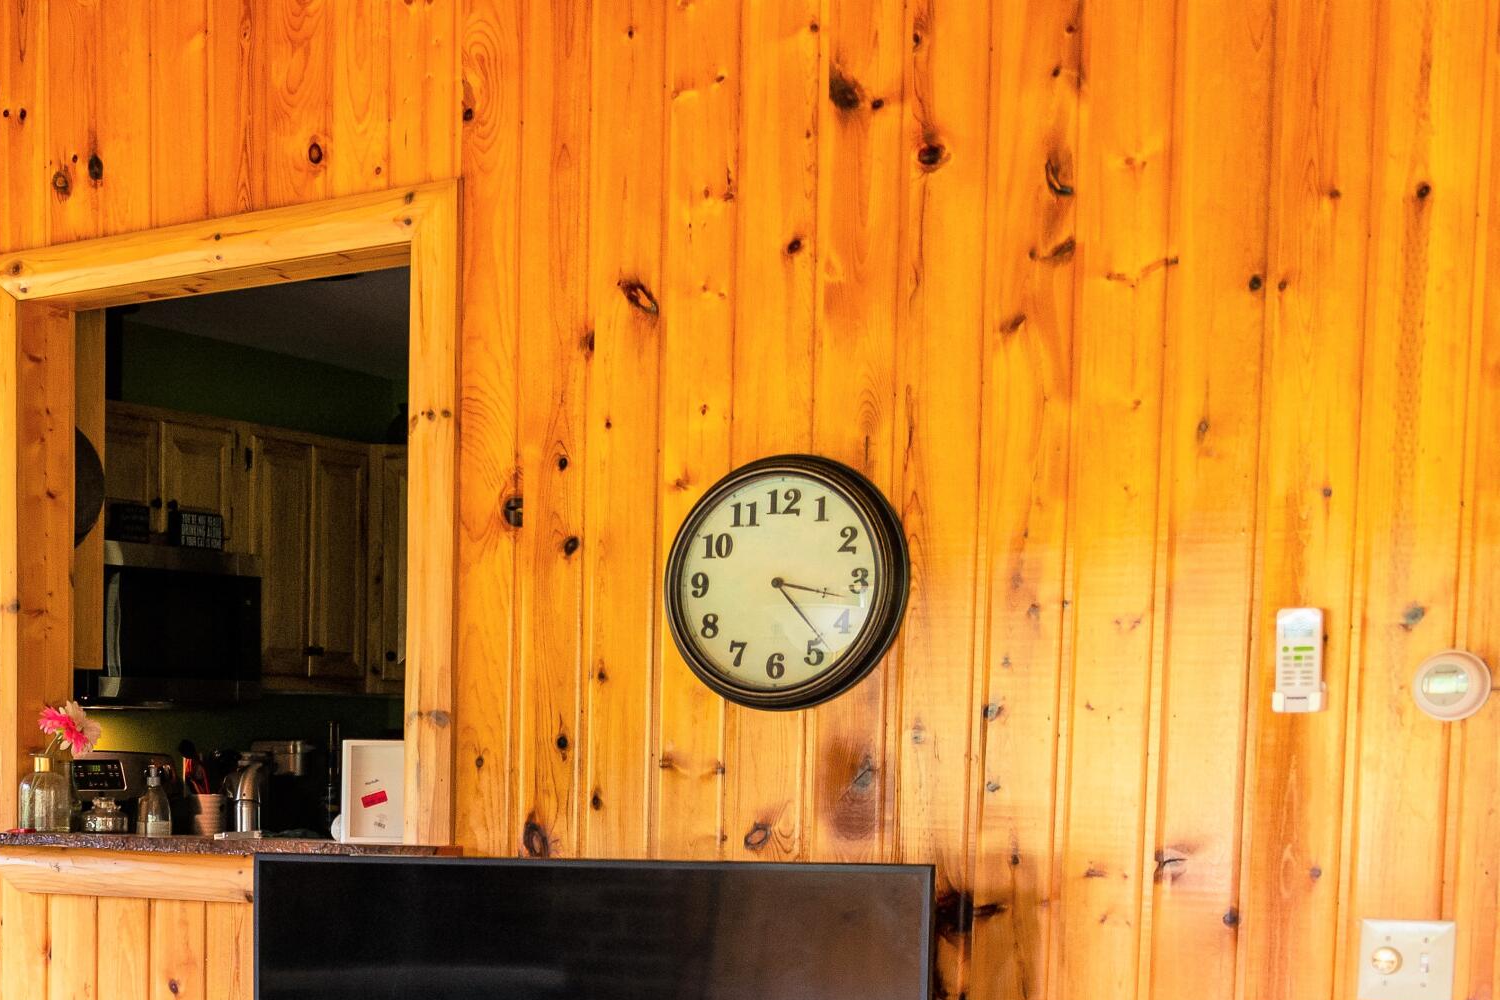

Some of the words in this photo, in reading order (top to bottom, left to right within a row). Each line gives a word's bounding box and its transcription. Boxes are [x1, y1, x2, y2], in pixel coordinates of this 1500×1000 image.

[729, 501, 760, 527] 11
[766, 488, 802, 517] 12
[813, 496, 829, 522] 1
[701, 532, 734, 559] 10
[837, 526, 859, 555] 2
[690, 572, 710, 599] 9
[848, 567, 870, 595] 3
[700, 613, 719, 639] 8
[833, 608, 852, 635] 4
[729, 639, 748, 667] 7
[803, 632, 825, 666] 5
[765, 653, 785, 680] 6
